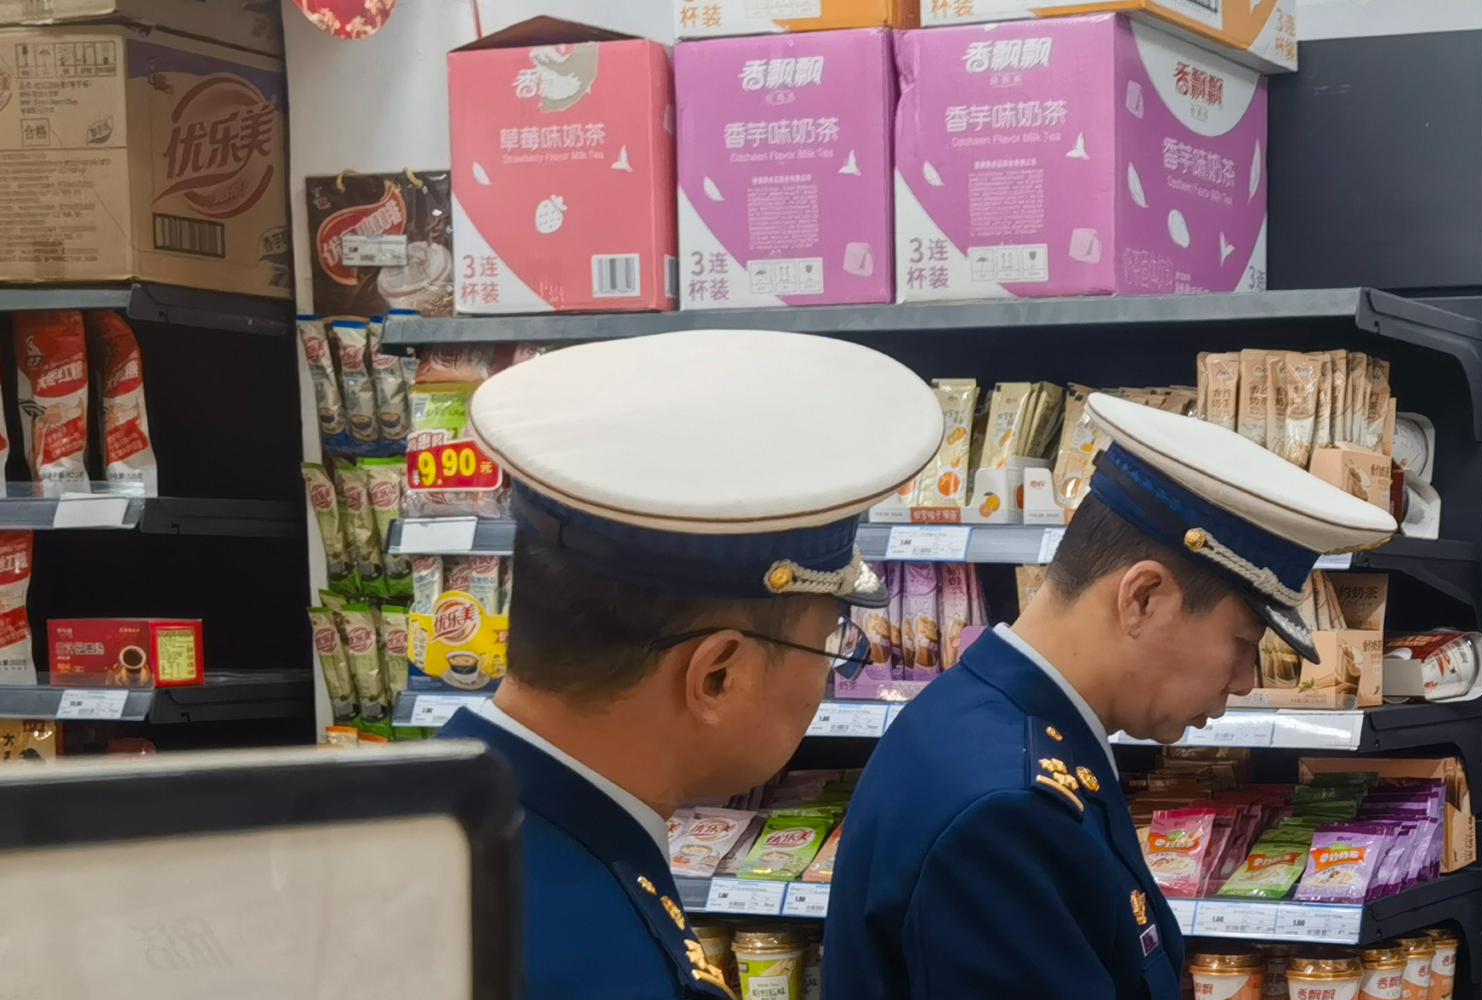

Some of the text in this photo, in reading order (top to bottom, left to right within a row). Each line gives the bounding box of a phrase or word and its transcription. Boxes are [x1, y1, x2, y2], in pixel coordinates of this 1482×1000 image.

[680, 5, 722, 28] 杯装
[961, 37, 1053, 74] 香飘飘
[738, 56, 825, 91] 香飘飘
[945, 99, 1068, 133] 香芋味奶茶
[163, 101, 275, 180] 优乐美
[500, 122, 607, 152] 草莓味奶茶
[724, 117, 840, 148] 香芋味奶茶
[691, 251, 729, 276] 3连
[909, 237, 949, 264] 3连
[462, 254, 499, 279] 3连
[907, 265, 949, 290] 杯装
[461, 282, 500, 304] 杯装
[688, 278, 730, 301] 杯装
[418, 448, 476, 486] 9.90
[434, 603, 477, 632] 优乐美
